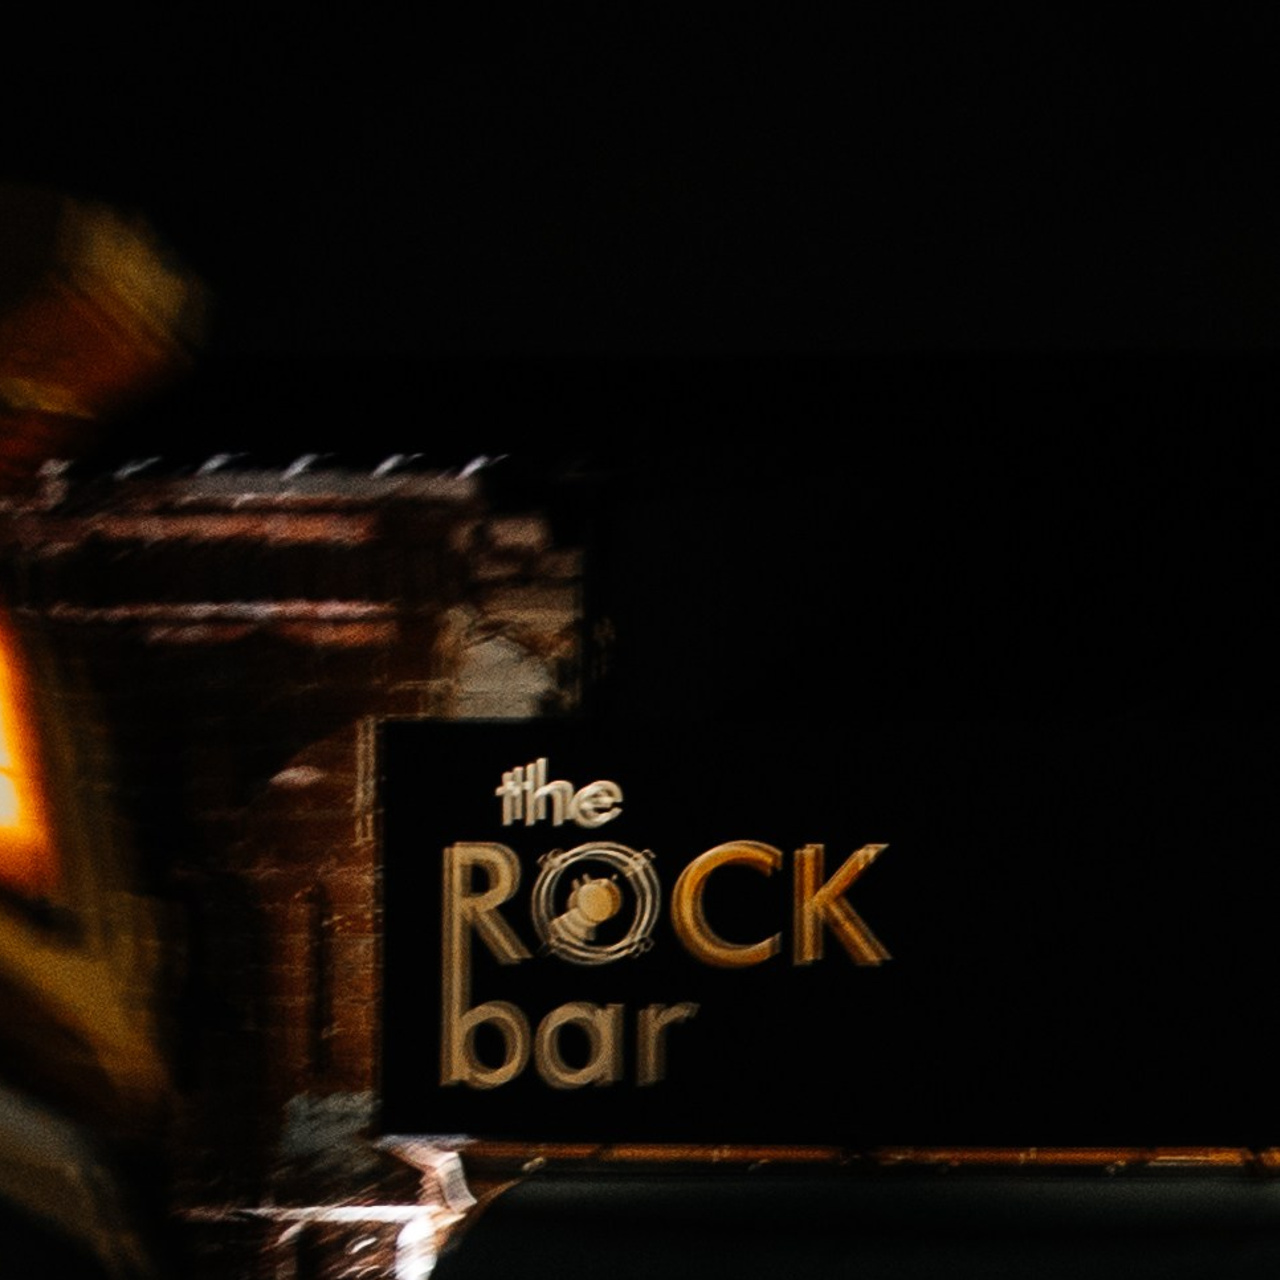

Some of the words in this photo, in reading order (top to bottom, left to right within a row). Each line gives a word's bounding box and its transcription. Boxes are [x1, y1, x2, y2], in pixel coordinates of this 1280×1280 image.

[495, 757, 624, 829] the
[441, 840, 892, 968] ROCK
[439, 966, 700, 1090] bar
